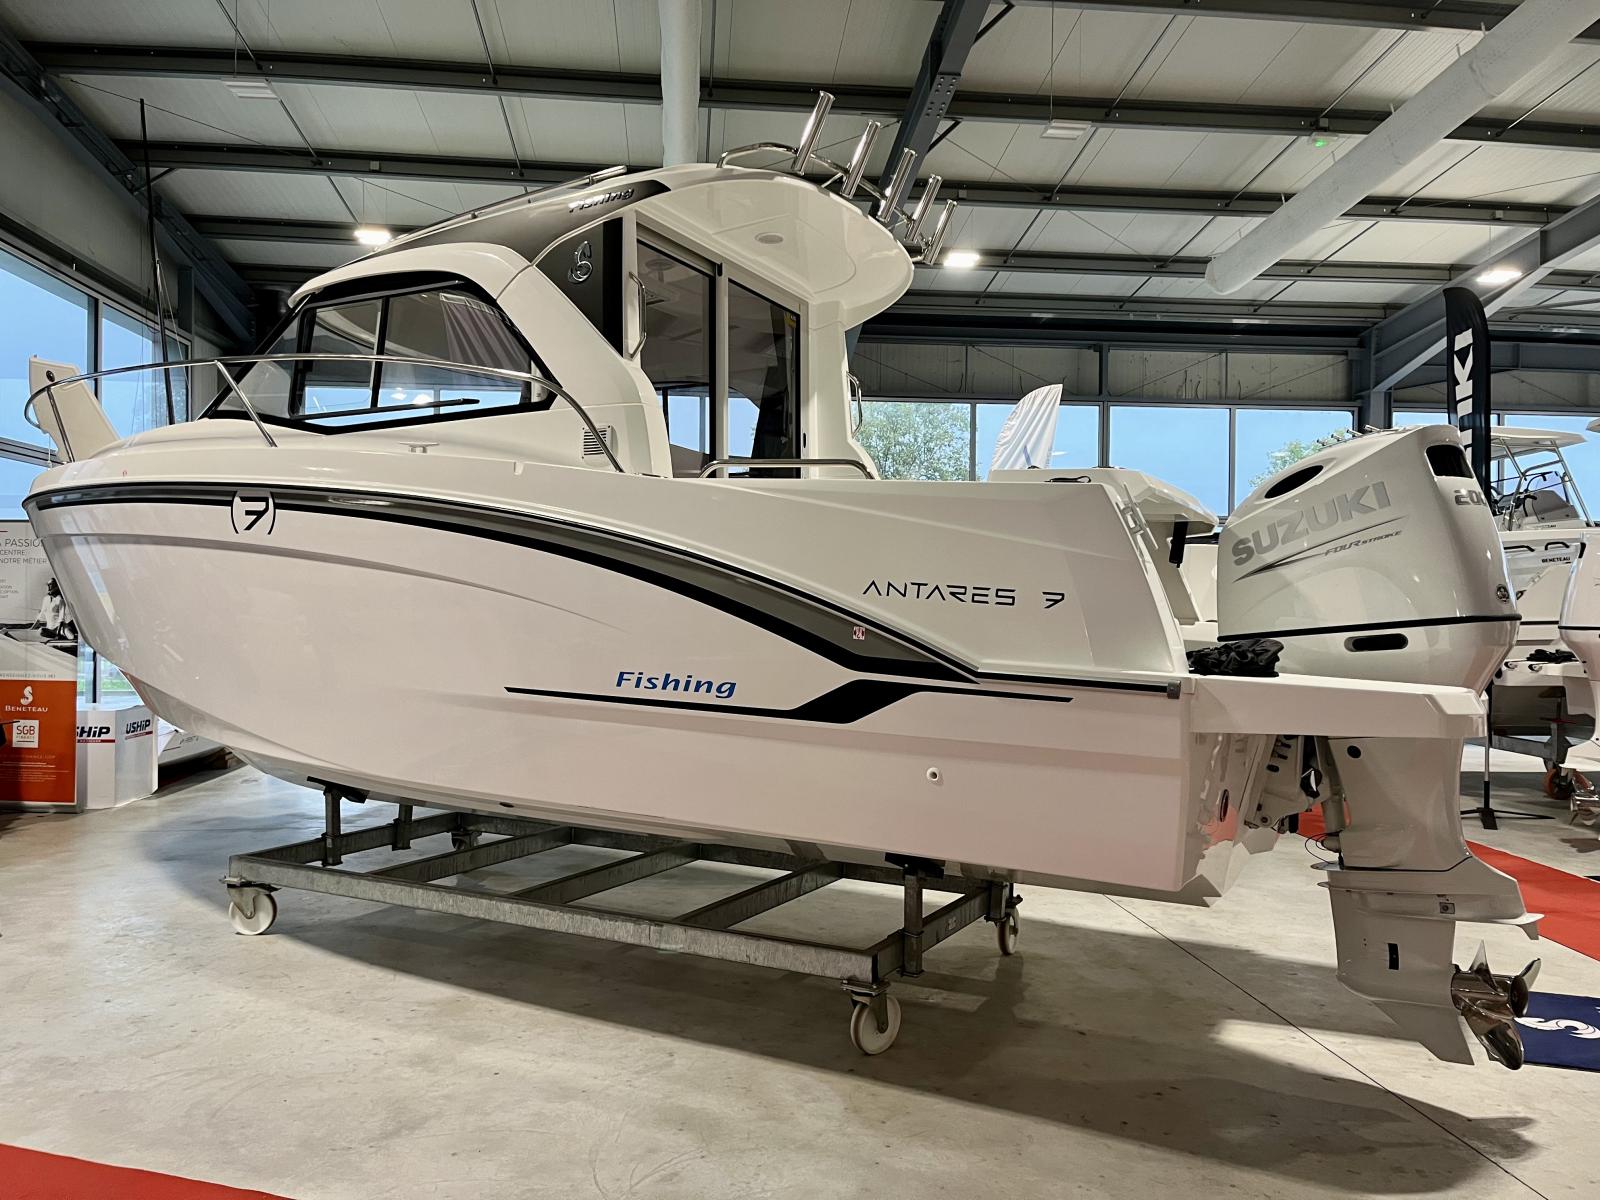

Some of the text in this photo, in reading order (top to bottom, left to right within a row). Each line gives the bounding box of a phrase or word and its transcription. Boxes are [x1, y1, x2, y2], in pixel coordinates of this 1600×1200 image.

[1232, 481, 1391, 566] SUZUKI
[4, 537, 43, 549] PASSIO
[862, 579, 1017, 607] ANTARES
[615, 671, 737, 699] Fishing
[16, 725, 36, 736] SGB
